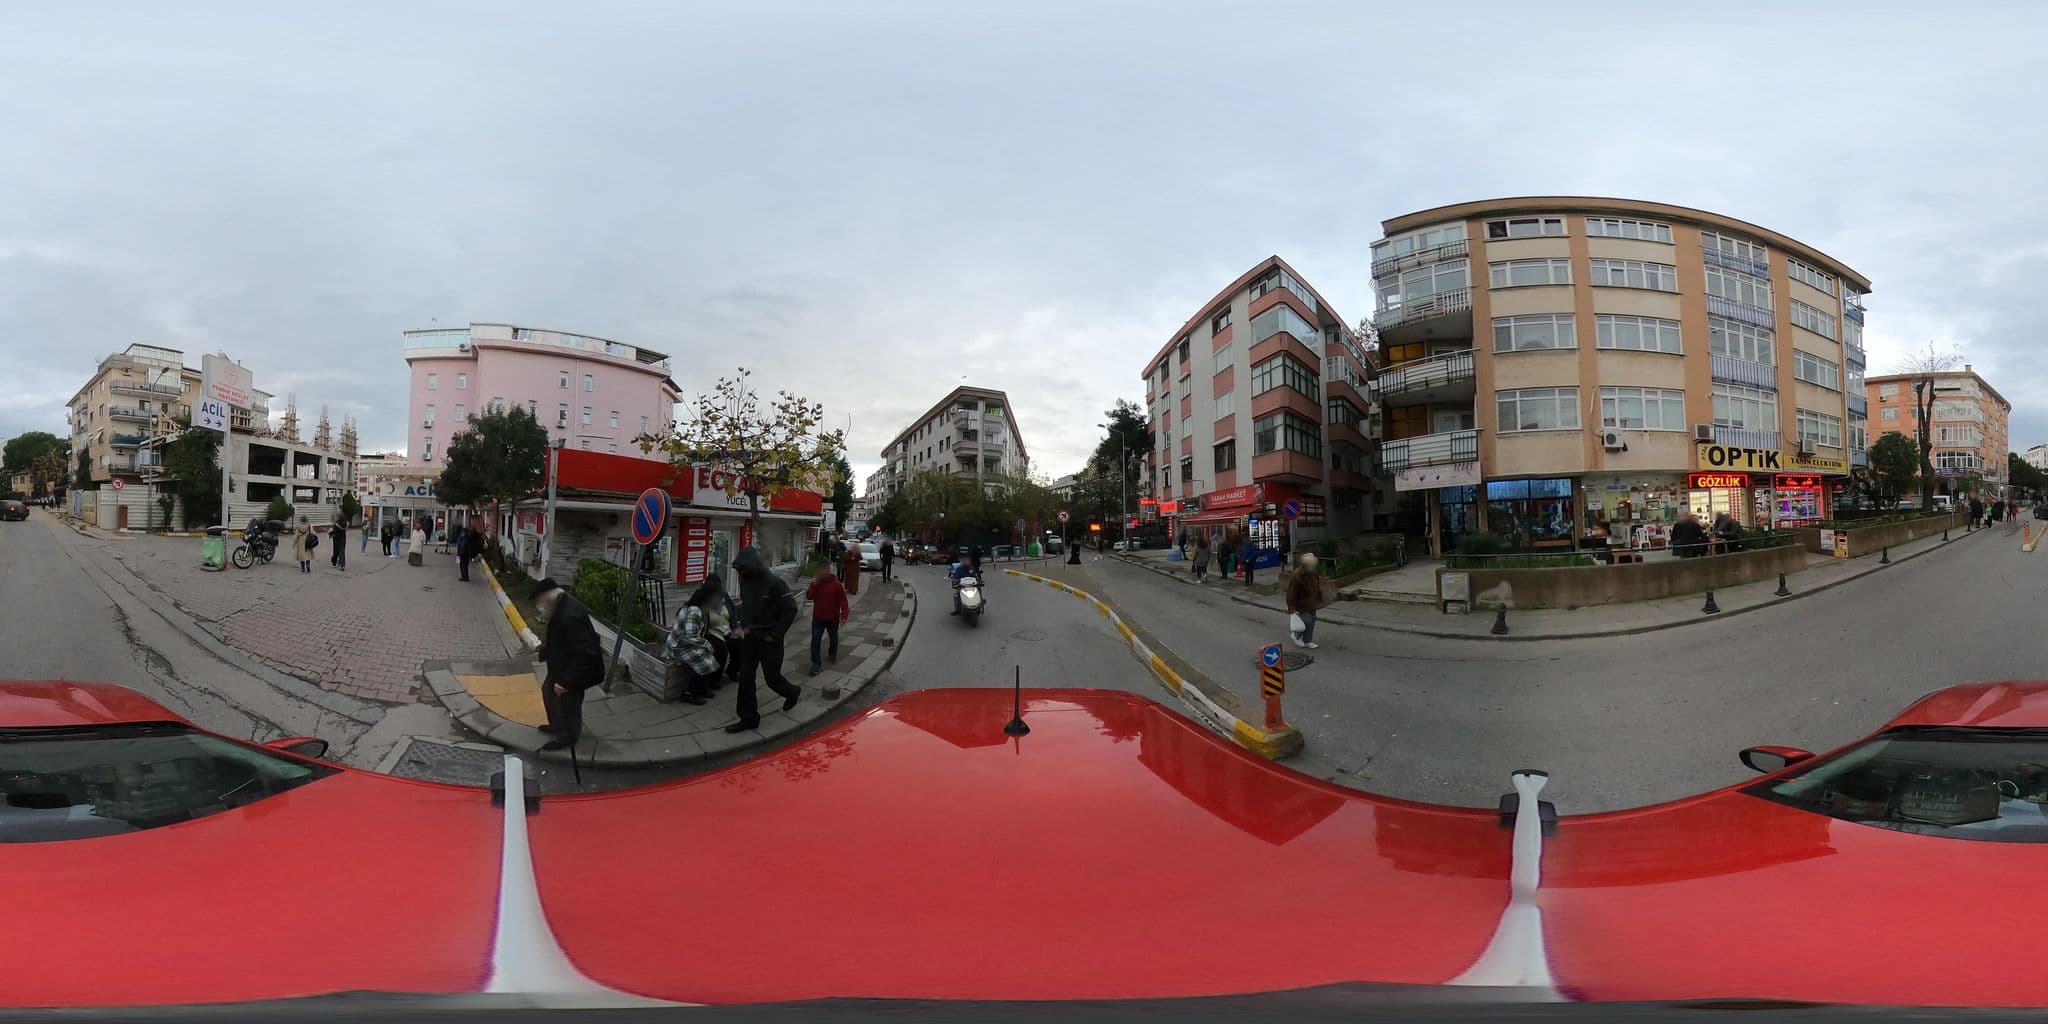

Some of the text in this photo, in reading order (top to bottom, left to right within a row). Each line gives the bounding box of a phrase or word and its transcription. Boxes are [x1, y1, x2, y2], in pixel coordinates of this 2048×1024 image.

[202, 402, 225, 418] ACİL
[1698, 475, 1740, 487] GÖZLÜK
[1226, 489, 1246, 499] MARKET
